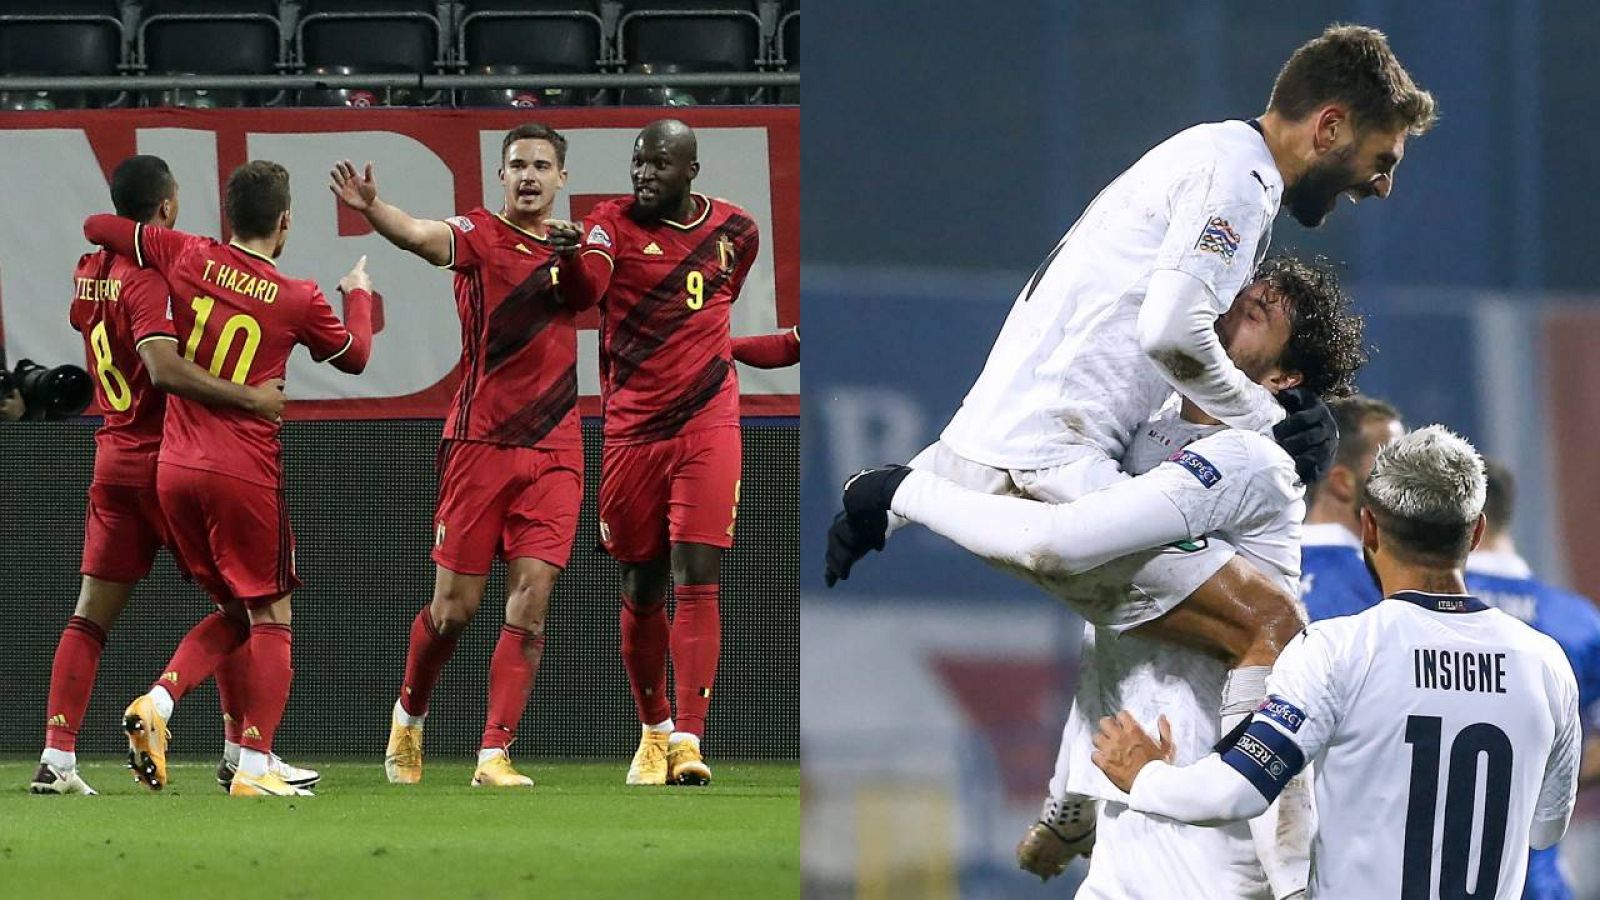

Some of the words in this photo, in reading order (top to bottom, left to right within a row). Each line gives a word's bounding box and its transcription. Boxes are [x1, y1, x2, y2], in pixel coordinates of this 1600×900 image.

[202, 260, 216, 283] T.
[215, 264, 279, 304] HAZARD
[682, 270, 704, 310] 9
[90, 320, 132, 412] 8
[184, 296, 262, 386] 10
[1414, 649, 1507, 694] INSIGNE
[1401, 714, 1513, 900] 10
